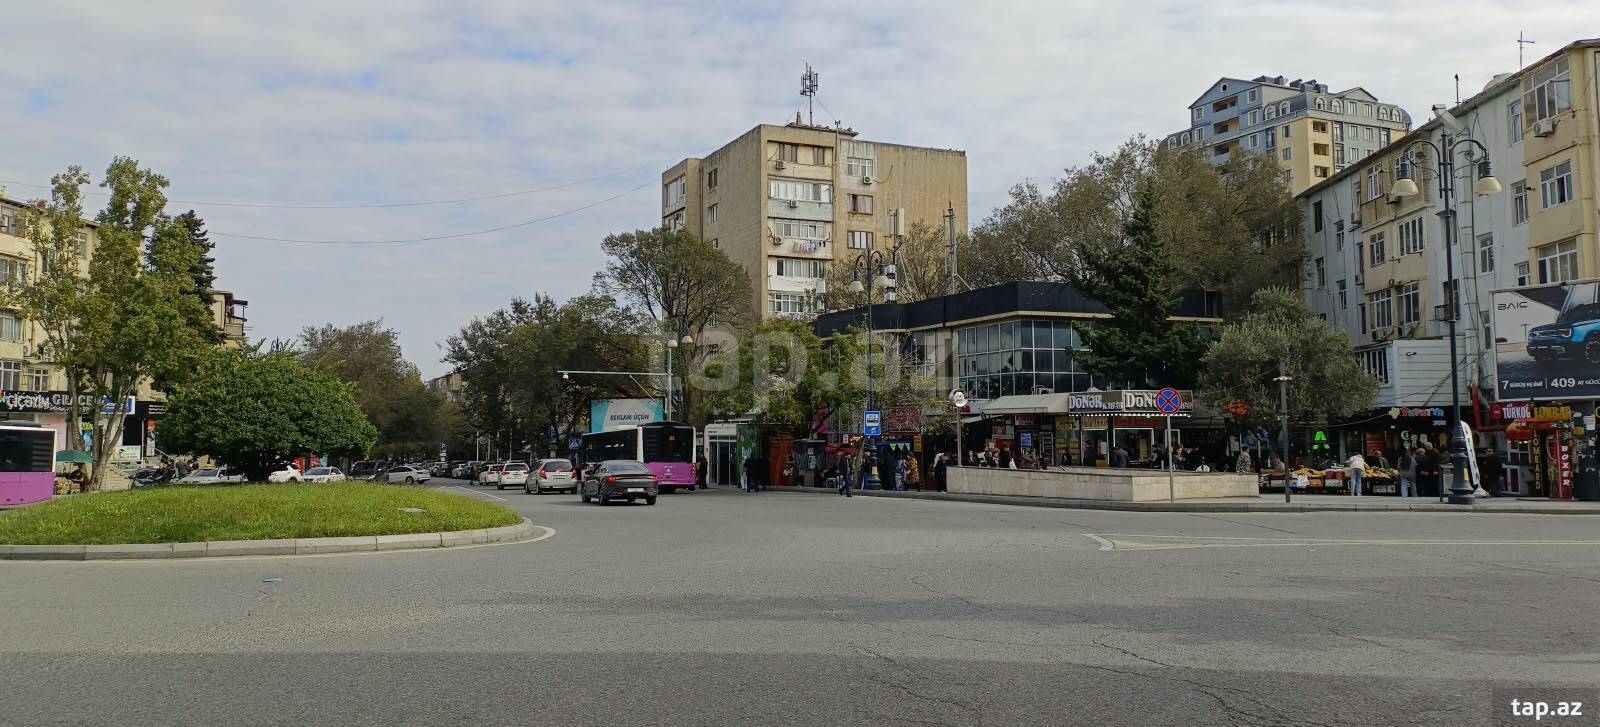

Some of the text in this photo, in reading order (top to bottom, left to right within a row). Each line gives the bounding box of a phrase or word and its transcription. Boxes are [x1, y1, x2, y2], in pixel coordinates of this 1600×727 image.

[1497, 301, 1528, 310] BAIC
[1502, 380, 1509, 390] 7
[1551, 378, 1575, 388] 409
[1126, 392, 1158, 408] DÖN
[1560, 445, 1571, 487] BOXER
